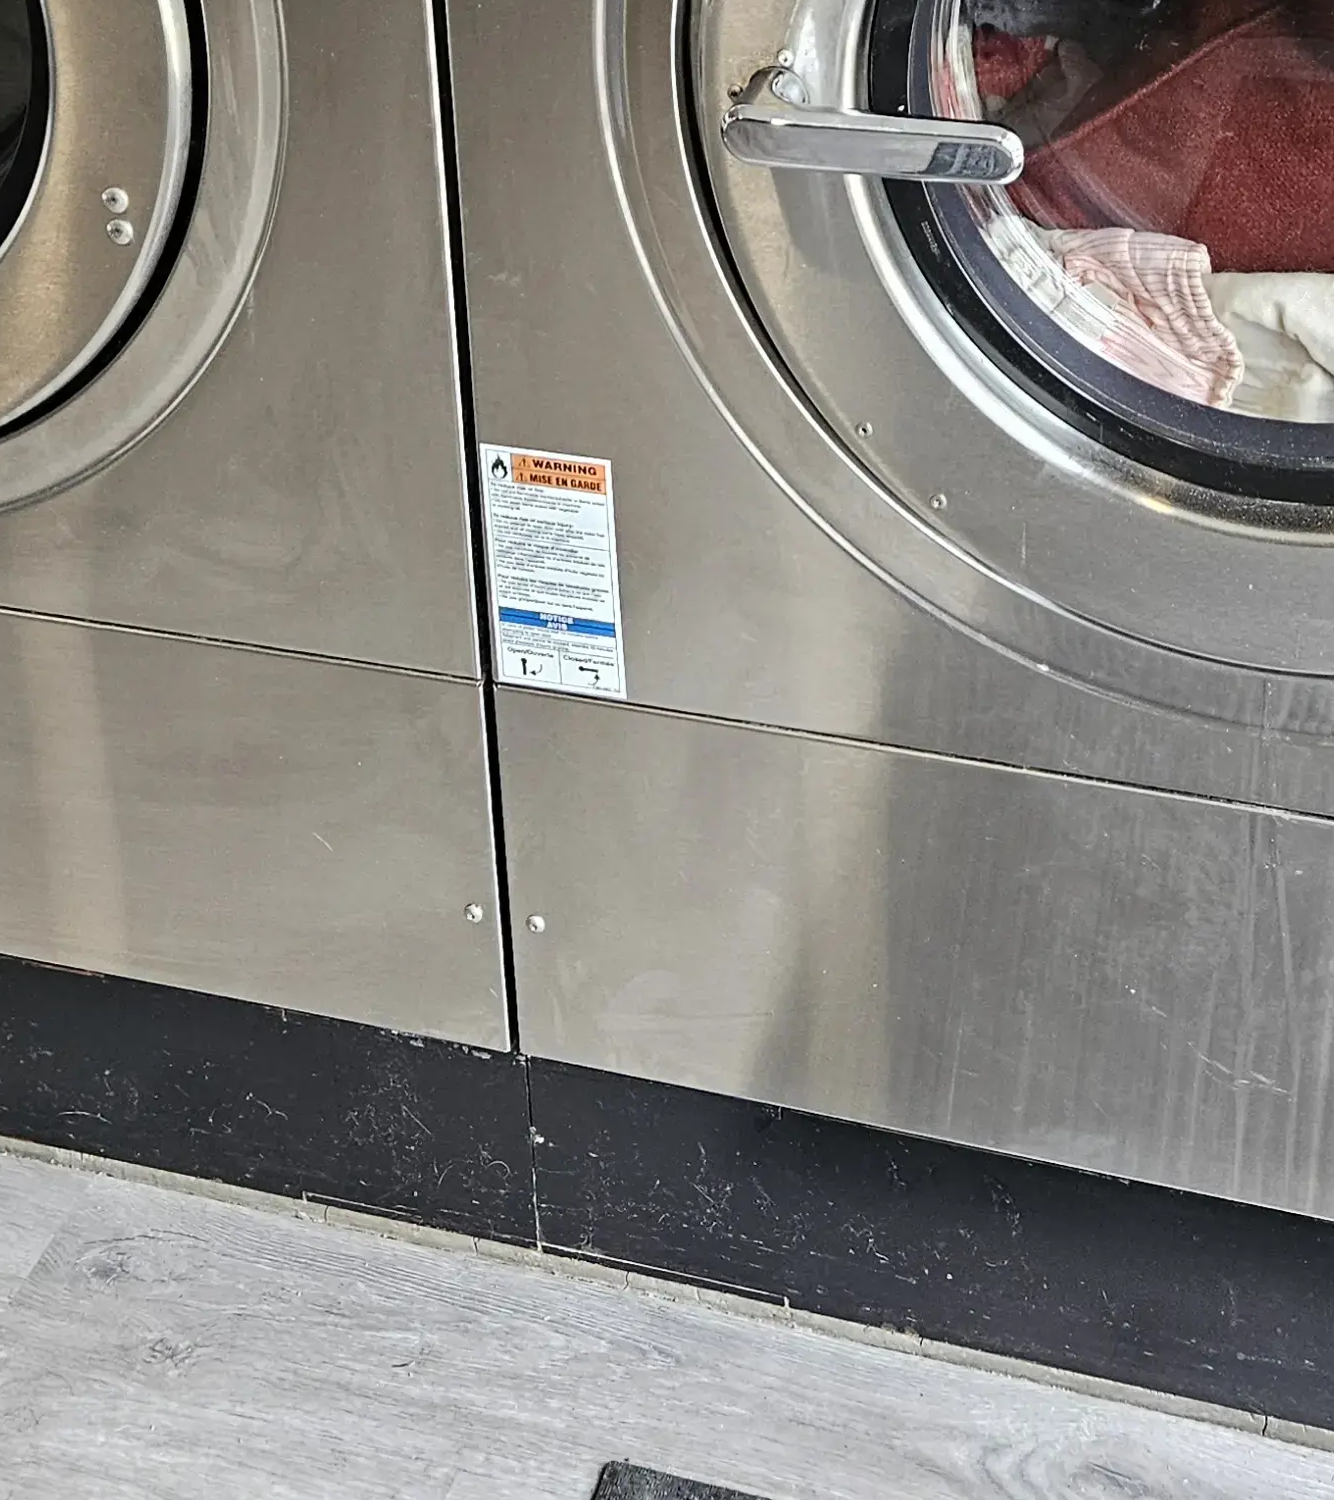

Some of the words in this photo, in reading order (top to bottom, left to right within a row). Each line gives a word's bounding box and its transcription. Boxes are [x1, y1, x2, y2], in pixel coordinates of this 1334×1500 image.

[532, 459, 597, 476] WARNING
[530, 473, 552, 484] MISE
[556, 477, 568, 487] EN
[570, 479, 601, 491] GARDE
[540, 613, 574, 624] NOTICE
